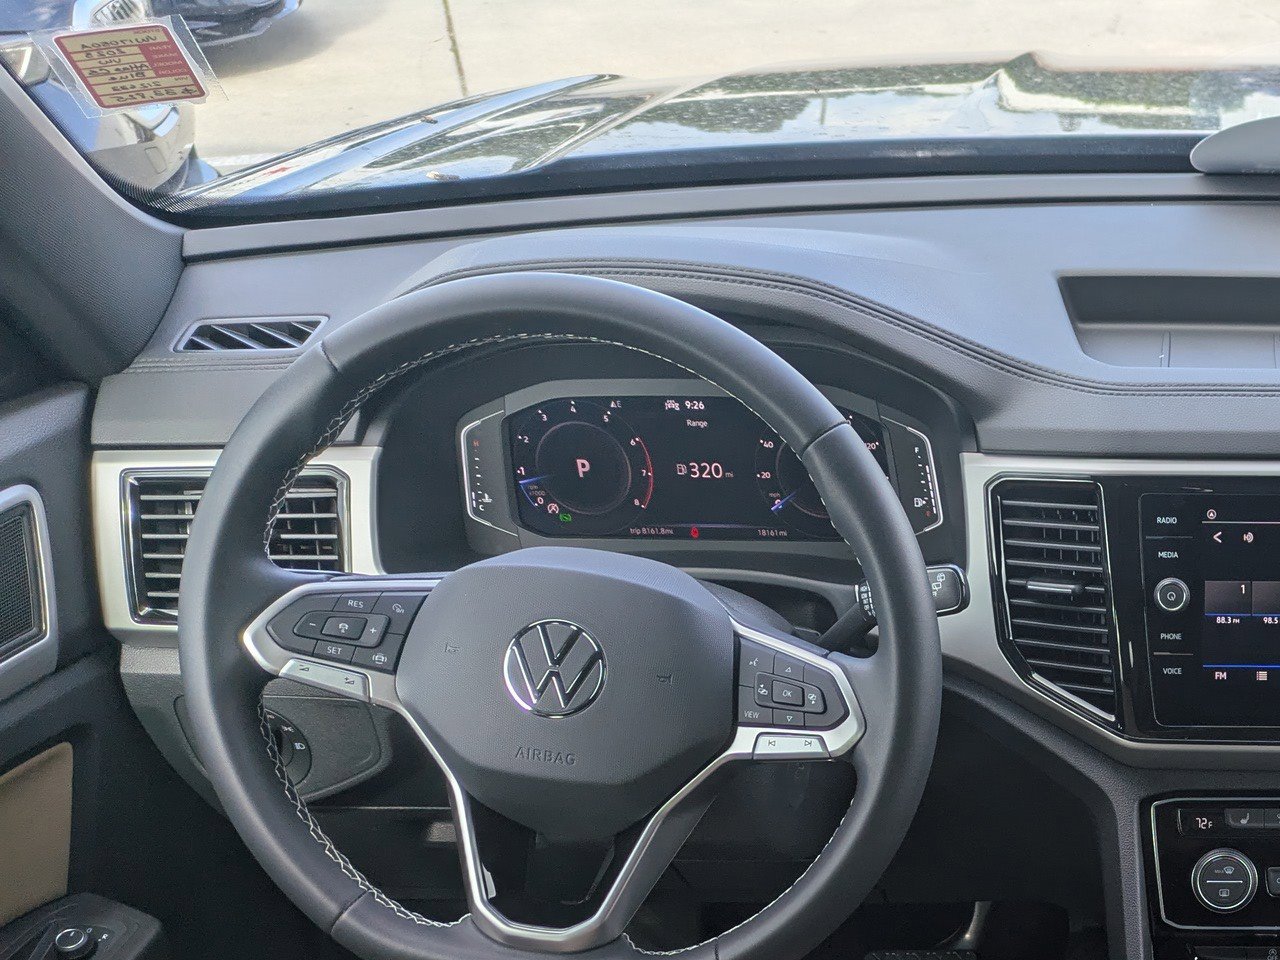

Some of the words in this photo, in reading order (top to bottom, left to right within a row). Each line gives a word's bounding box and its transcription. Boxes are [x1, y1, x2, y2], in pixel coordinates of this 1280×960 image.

[685, 401, 705, 410] 9:26
[603, 415, 609, 423] 5
[686, 420, 708, 428] Range
[763, 441, 774, 449] 40
[576, 459, 591, 478] P
[689, 462, 723, 478] 320
[641, 469, 646, 477] 7
[537, 496, 544, 504] 0
[1156, 516, 1178, 524] RADIO
[1158, 551, 1179, 559] MEDIA
[1240, 584, 1245, 594] 1
[347, 599, 364, 609] RES
[1216, 616, 1231, 624] 88.3
[1263, 616, 1279, 624] 98.5
[326, 646, 342, 656] SET
[1162, 667, 1182, 675] VOICE
[1214, 671, 1227, 680] FM
[782, 690, 793, 698] OK
[744, 710, 760, 719] VIEW
[514, 746, 577, 766] AIRBAG
